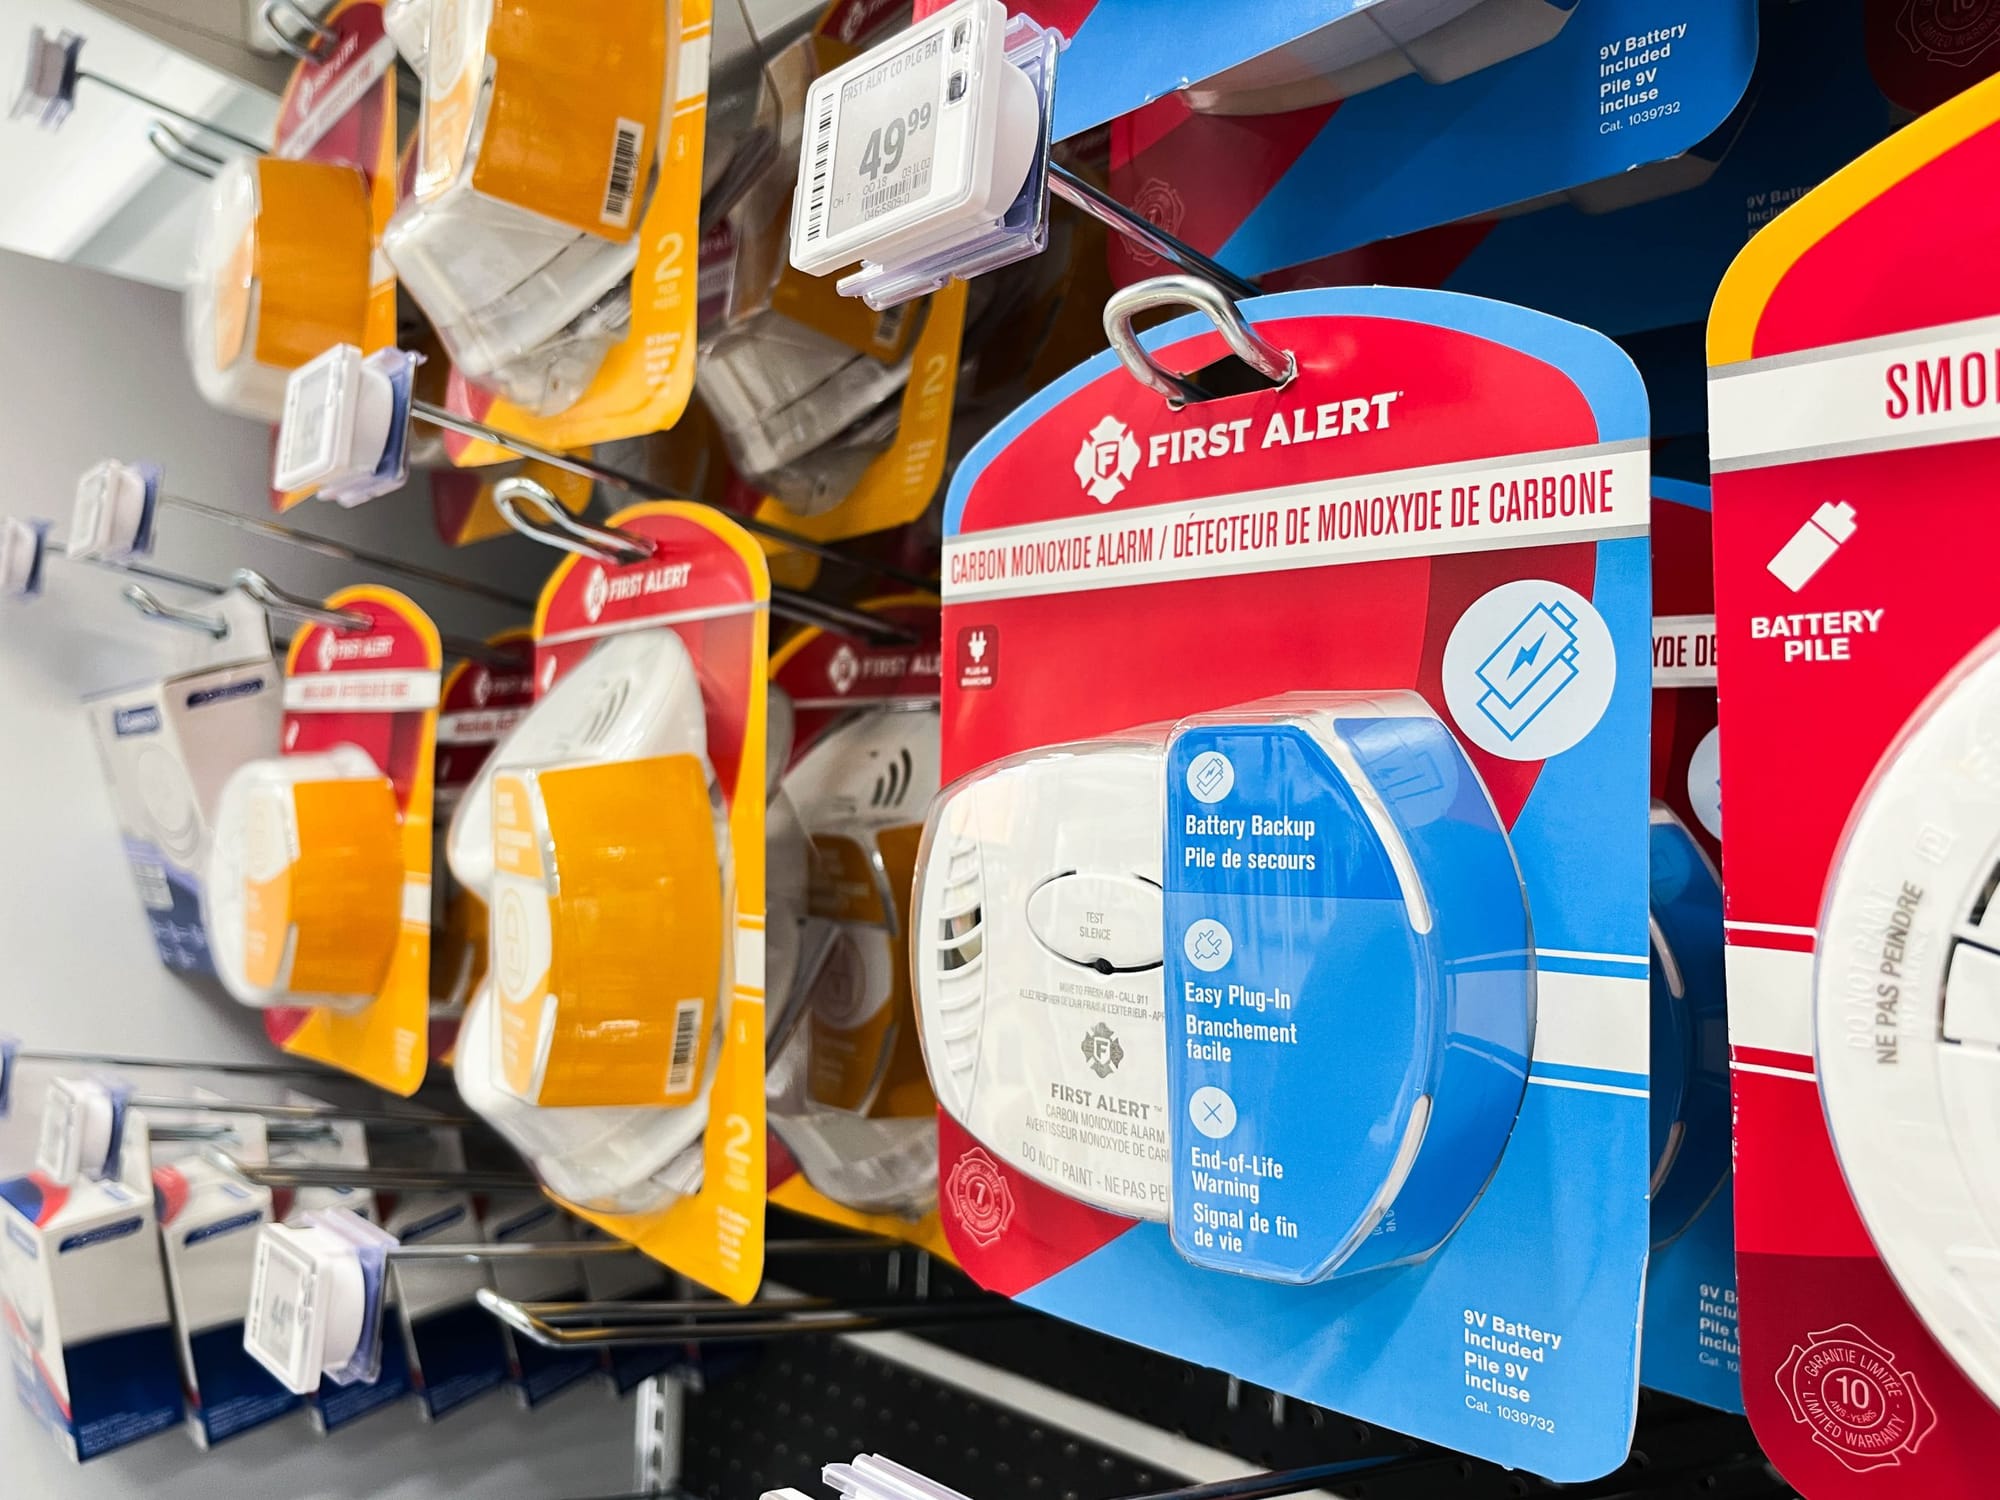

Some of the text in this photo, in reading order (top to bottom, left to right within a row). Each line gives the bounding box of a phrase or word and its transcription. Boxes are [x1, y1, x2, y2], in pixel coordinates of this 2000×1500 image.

[1600, 22, 1687, 60] 9V Battery
[843, 80, 863, 104] FRST
[866, 66, 888, 91] ALRT
[890, 59, 902, 78] CO
[905, 48, 922, 71] PLG
[1600, 43, 1671, 77] Included
[1600, 67, 1657, 98] Pile 9V
[1600, 87, 1659, 115] incluse
[1600, 101, 1681, 135] Cat. 1039732
[654, 232, 684, 282] 2
[1148, 390, 1398, 468] FIRST ALERT
[951, 469, 1613, 585] CARBON MONOXIDE ALARM / DÉTECTEUR DE MONOXYDE DE CARBONE
[607, 563, 691, 602] FIRST ALERT
[1751, 608, 1885, 639] BATTERY
[1784, 637, 1851, 662] PILE
[1185, 814, 1316, 841] Battery Backup
[1185, 847, 1316, 871] Pile de secours
[1079, 926, 1112, 941] SILENCE
[1086, 911, 1104, 925] TEST
[1880, 880, 1924, 978] PEINDRE
[1119, 991, 1136, 1004] CALL
[1136, 993, 1149, 1005] 911
[1184, 982, 1290, 1013] Easy Plug-In
[1876, 982, 1900, 1028] PAS
[1186, 1014, 1297, 1044] Branchement
[1186, 1038, 1232, 1063] facile
[1877, 1034, 1900, 1066] NE
[1051, 1083, 1092, 1107] FIRST
[1097, 1095, 1150, 1120] ALERT
[1025, 1115, 1078, 1142] AVERTISSEUR
[1080, 1129, 1130, 1155] MONOXYDE
[1133, 1142, 1145, 1159] DE
[1045, 1103, 1166, 1144] CARBON MONOXIDE ALARM
[1022, 1142, 1036, 1163] DO
[1038, 1151, 1059, 1174] NOT
[1062, 1161, 1093, 1187] PAINT
[1104, 1175, 1120, 1196] NE
[1123, 1179, 1147, 1200] PAS
[1191, 1147, 1283, 1180] End-of-Life
[976, 1182, 987, 1204] 7
[1192, 1170, 1259, 1205] Warning
[1193, 1202, 1298, 1239] Signal de fin
[1194, 1227, 1242, 1253] de vie
[1699, 1283, 1720, 1300] 9V
[1463, 1309, 1562, 1350] 9V Battery
[1700, 1317, 1730, 1337] Pile
[1464, 1328, 1544, 1363] Included
[1464, 1351, 1529, 1381] Pile 9V
[1804, 1348, 1903, 1398] GARANTIE LIMITÉE
[1465, 1370, 1530, 1403] incluse
[1836, 1376, 1870, 1409] 10
[1465, 1395, 1555, 1434] Cat. 1039732
[1802, 1391, 1905, 1448] LIMITED WARRANTY
[1851, 1409, 1877, 1424] YEARS
